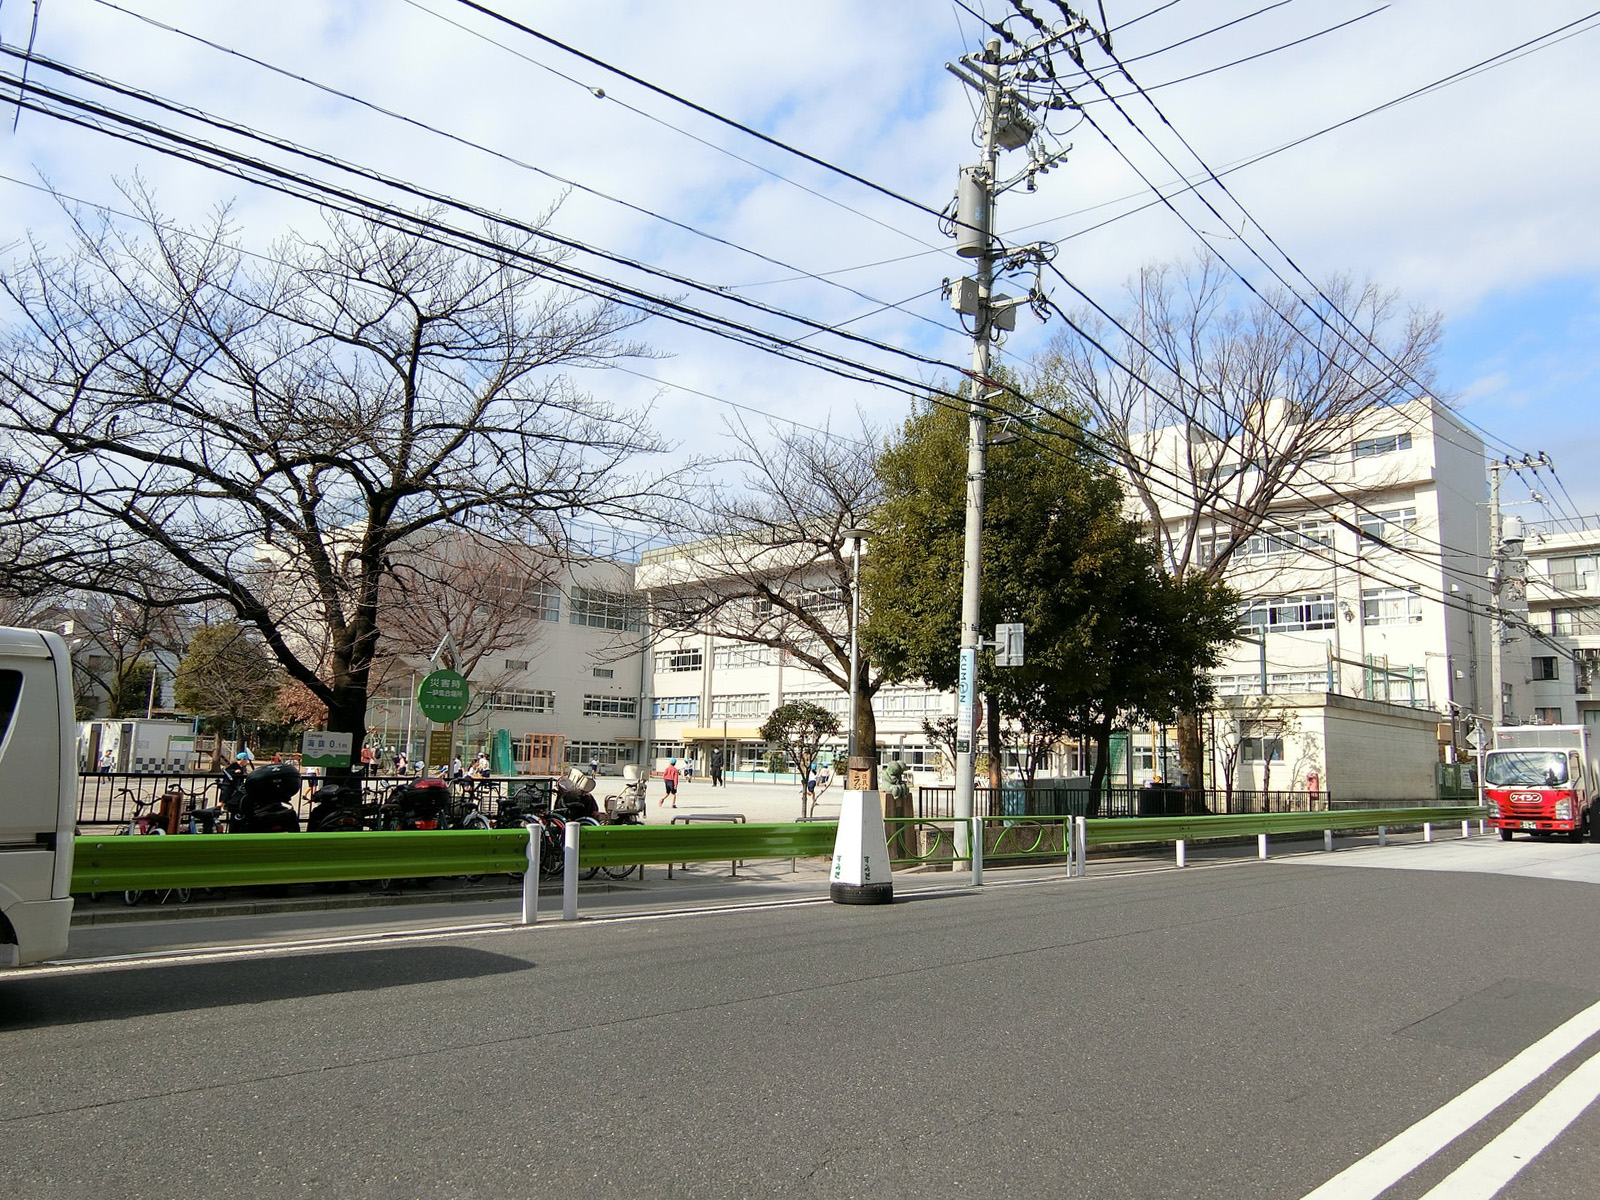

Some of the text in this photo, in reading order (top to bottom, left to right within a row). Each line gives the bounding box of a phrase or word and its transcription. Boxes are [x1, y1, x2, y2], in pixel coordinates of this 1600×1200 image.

[430, 678, 461, 689] 災害時
[959, 655, 969, 703] KUMON
